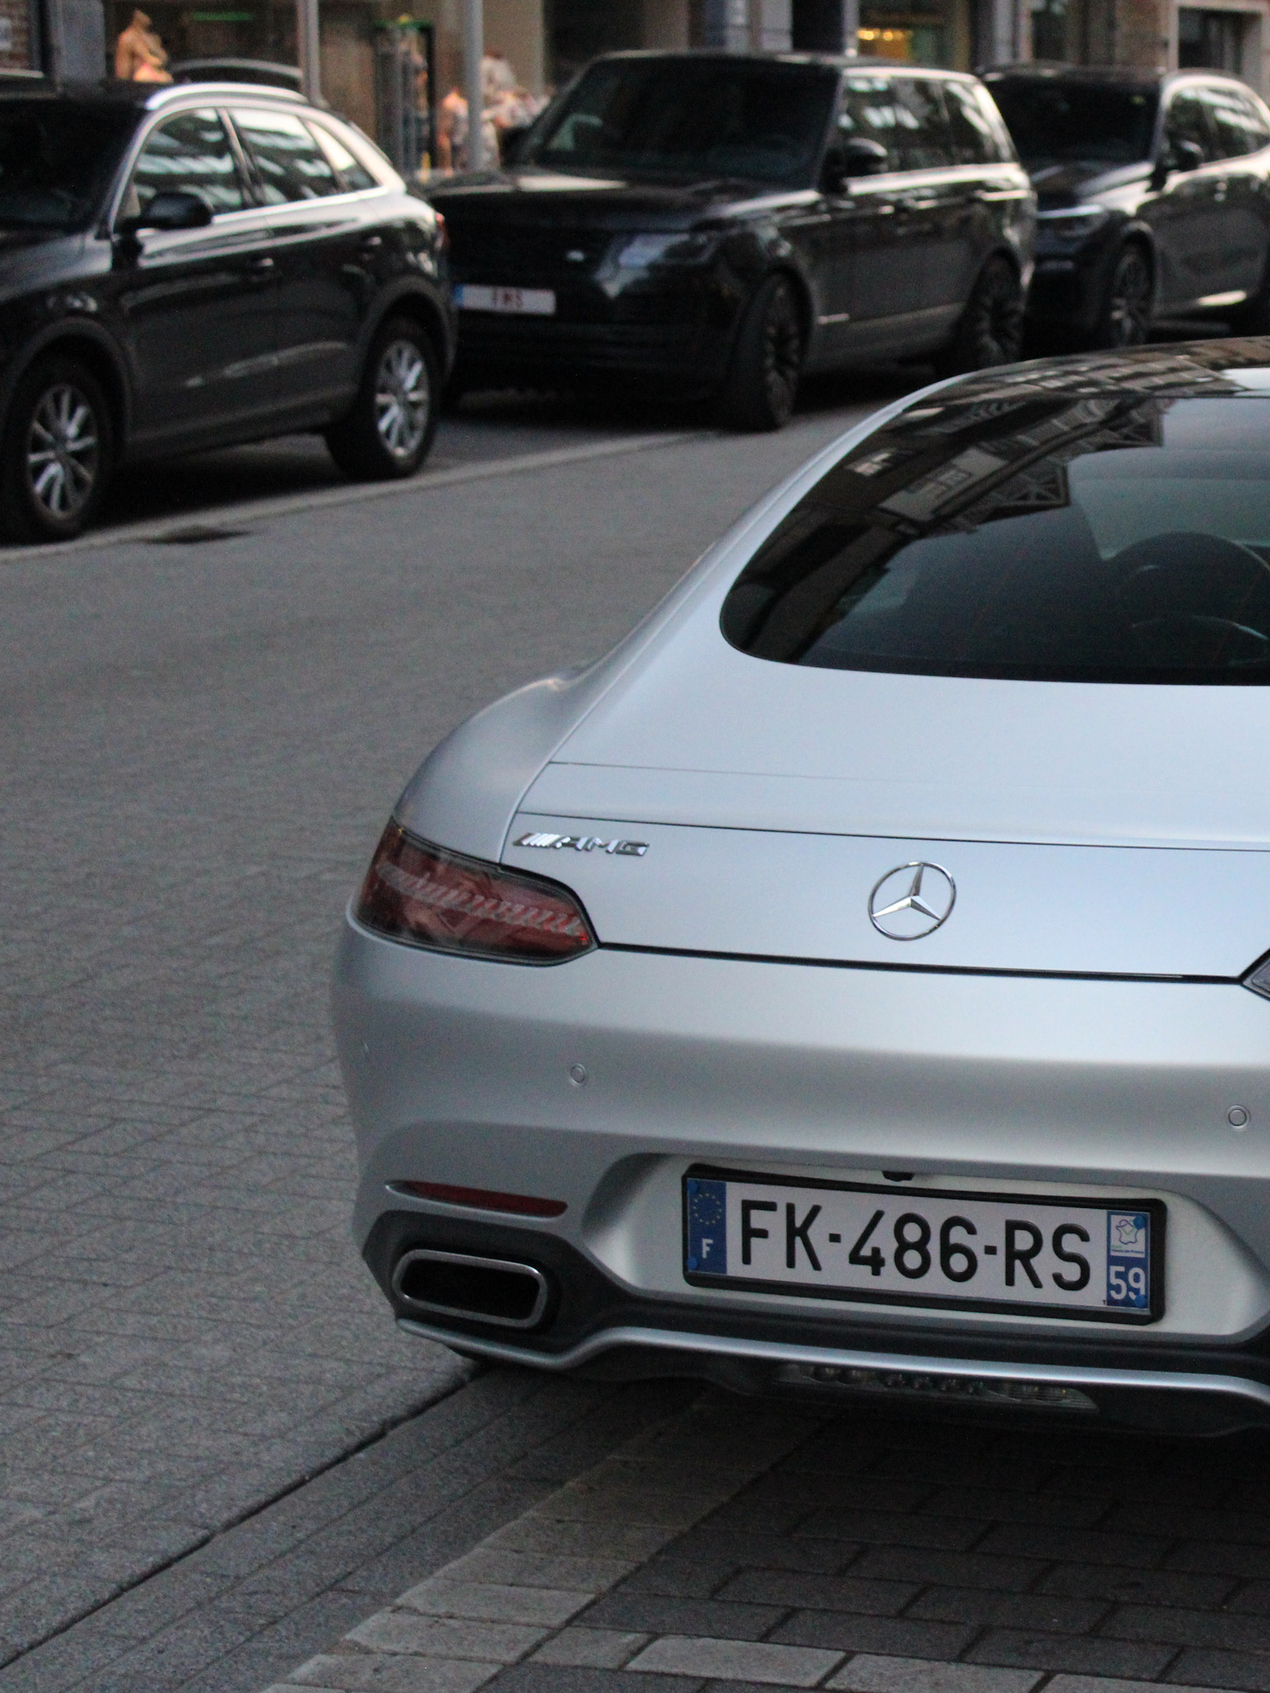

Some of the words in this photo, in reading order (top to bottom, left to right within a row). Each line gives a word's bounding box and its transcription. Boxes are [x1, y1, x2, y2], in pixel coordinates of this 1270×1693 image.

[553, 835, 650, 857] AMG
[702, 1238, 714, 1259] F
[741, 1199, 1091, 1292] FK-486-RS
[1110, 1265, 1146, 1300] 59
